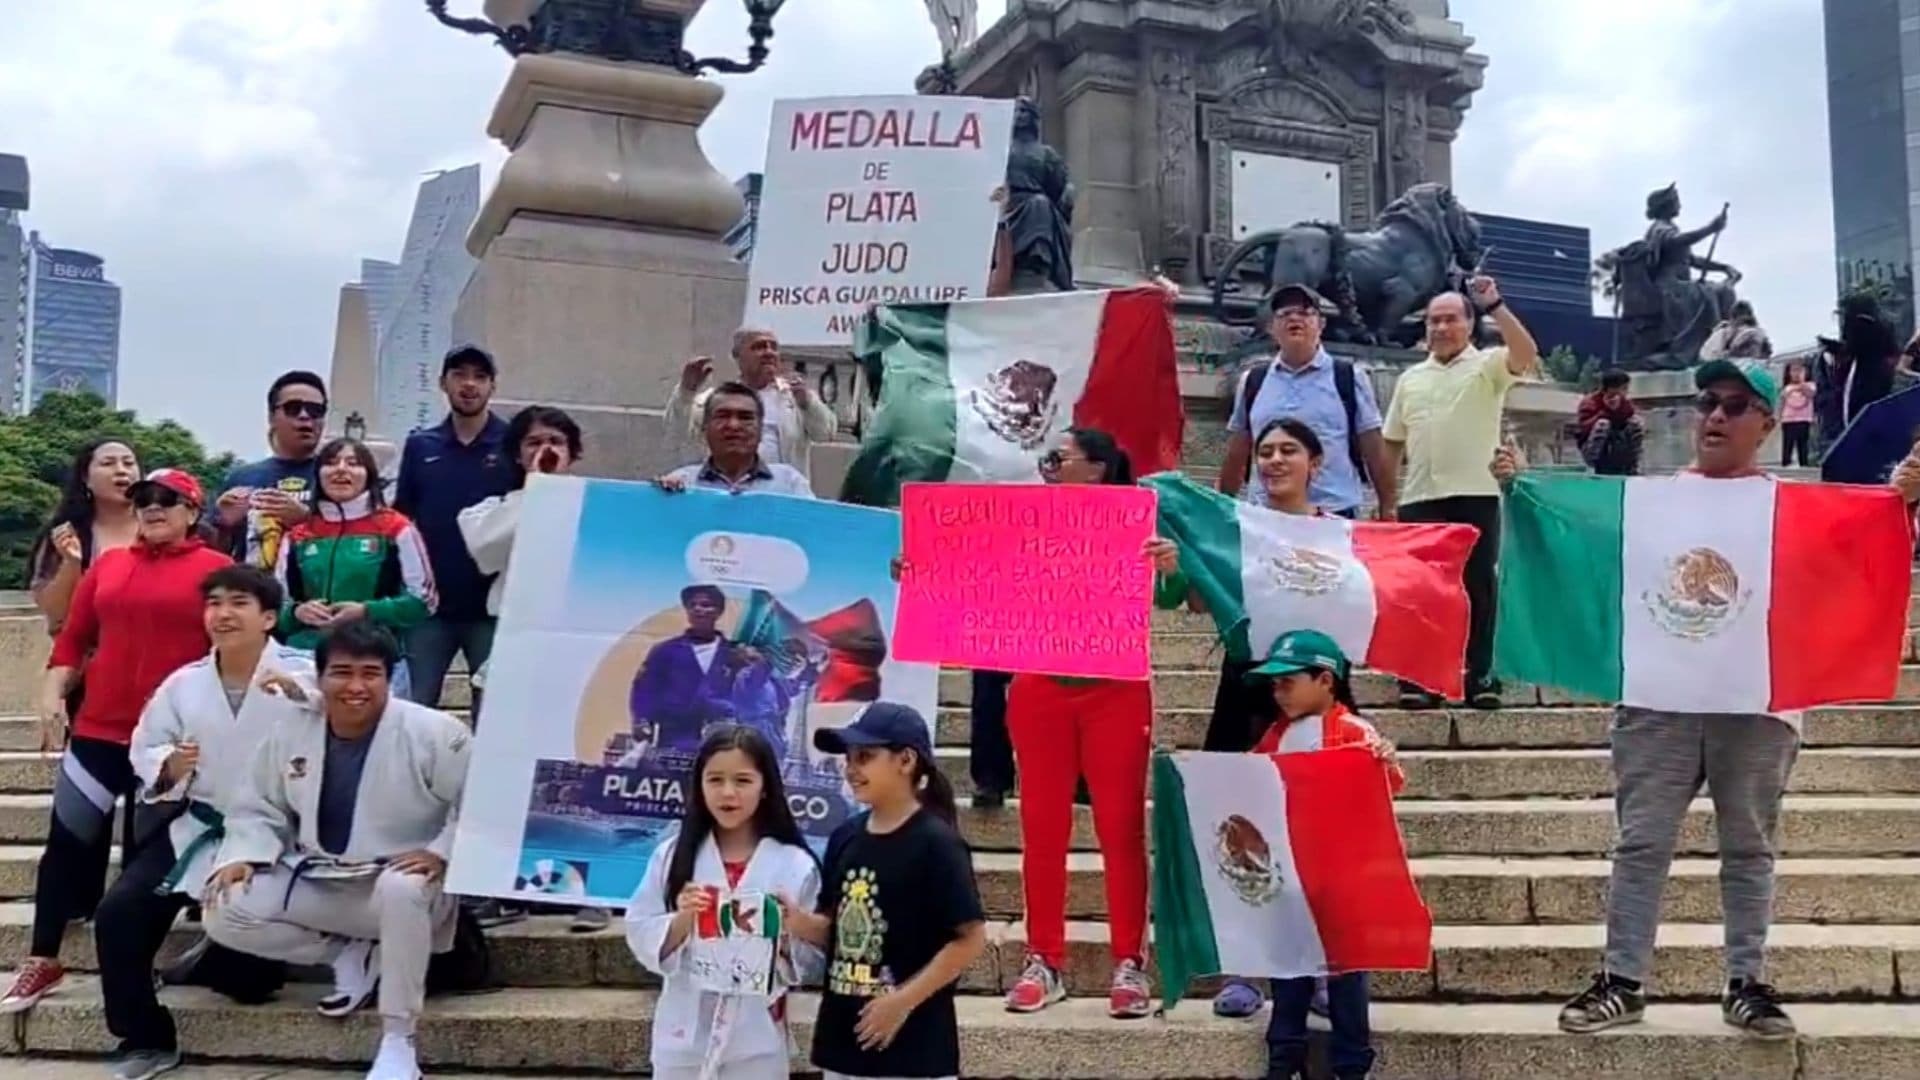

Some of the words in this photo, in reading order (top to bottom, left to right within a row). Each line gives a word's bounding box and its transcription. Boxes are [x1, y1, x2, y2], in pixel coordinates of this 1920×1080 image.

[790, 109, 982, 151] MEDALLA
[863, 162, 890, 181] DE
[826, 191, 918, 224] PLATA
[54, 263, 101, 279] BBVA
[822, 242, 908, 274] JUDO
[759, 286, 830, 305] PRISCA
[602, 773, 684, 803] PLATA
